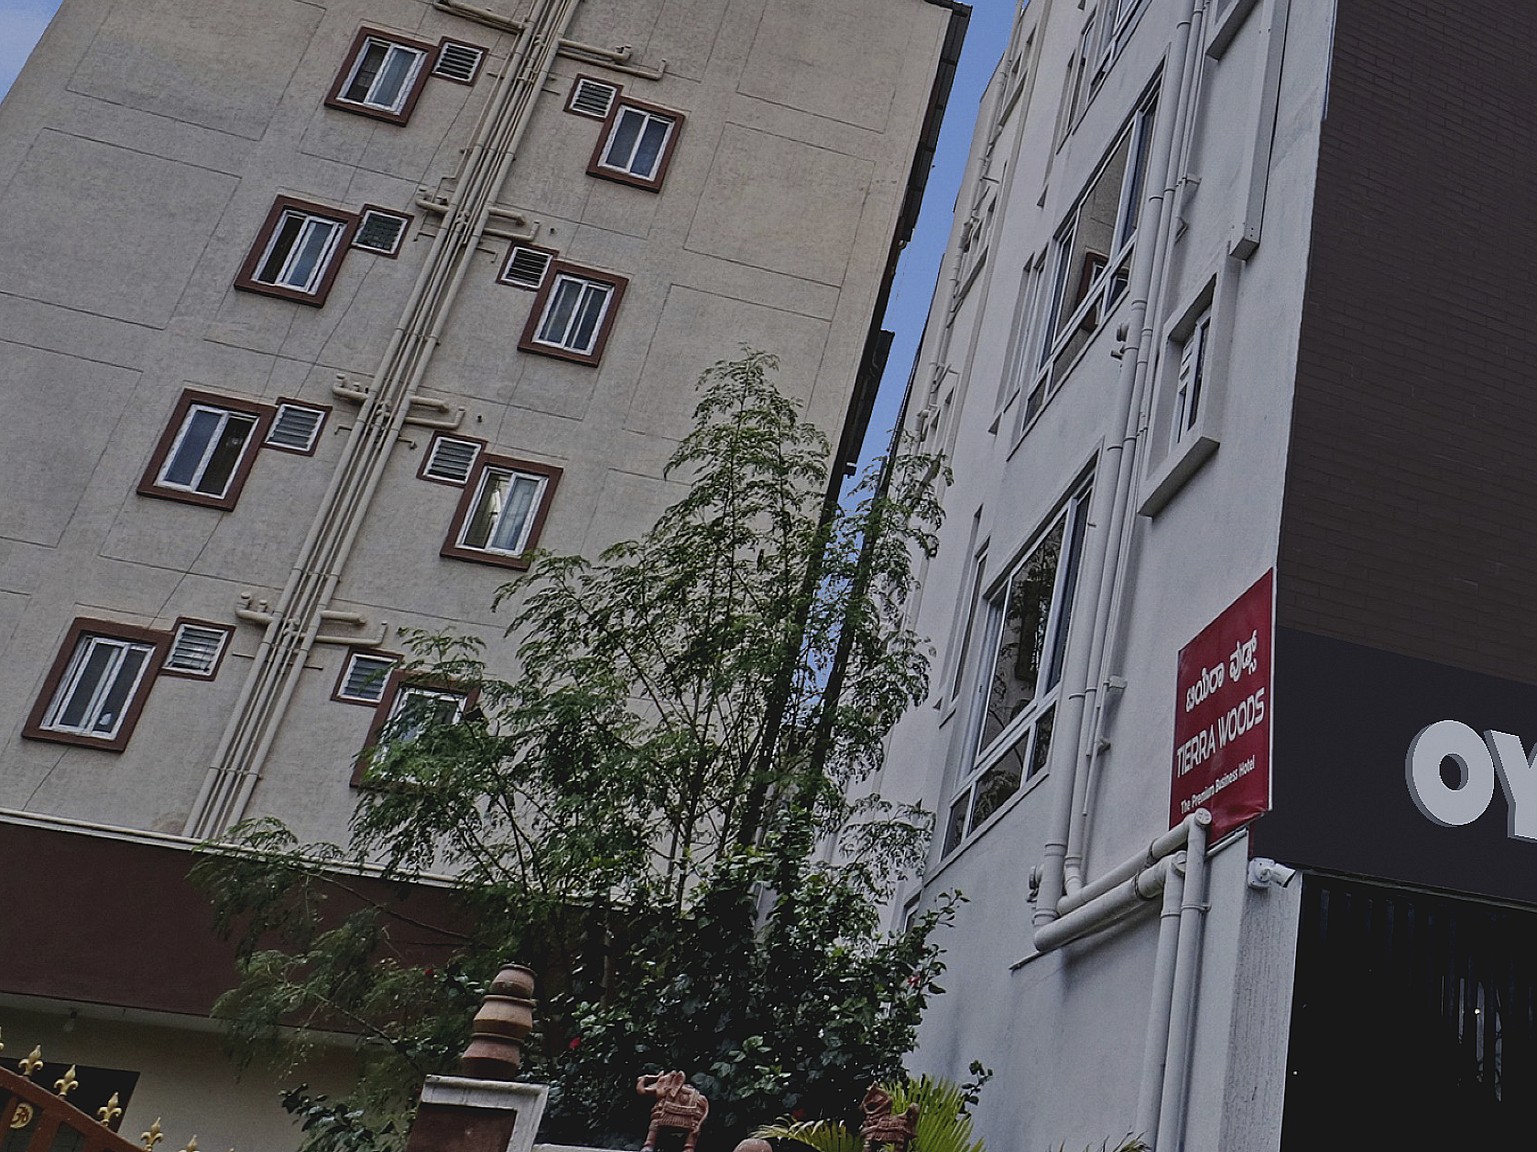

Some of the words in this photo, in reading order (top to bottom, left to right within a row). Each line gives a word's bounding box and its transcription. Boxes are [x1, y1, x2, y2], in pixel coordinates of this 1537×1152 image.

[1176, 730, 1216, 778] TIERRA
[1218, 687, 1265, 749] WOODS
[1180, 799, 1191, 814] The
[1191, 784, 1215, 808] Premium
[1215, 768, 1238, 794] Business
[1238, 754, 1256, 777] Hotel
